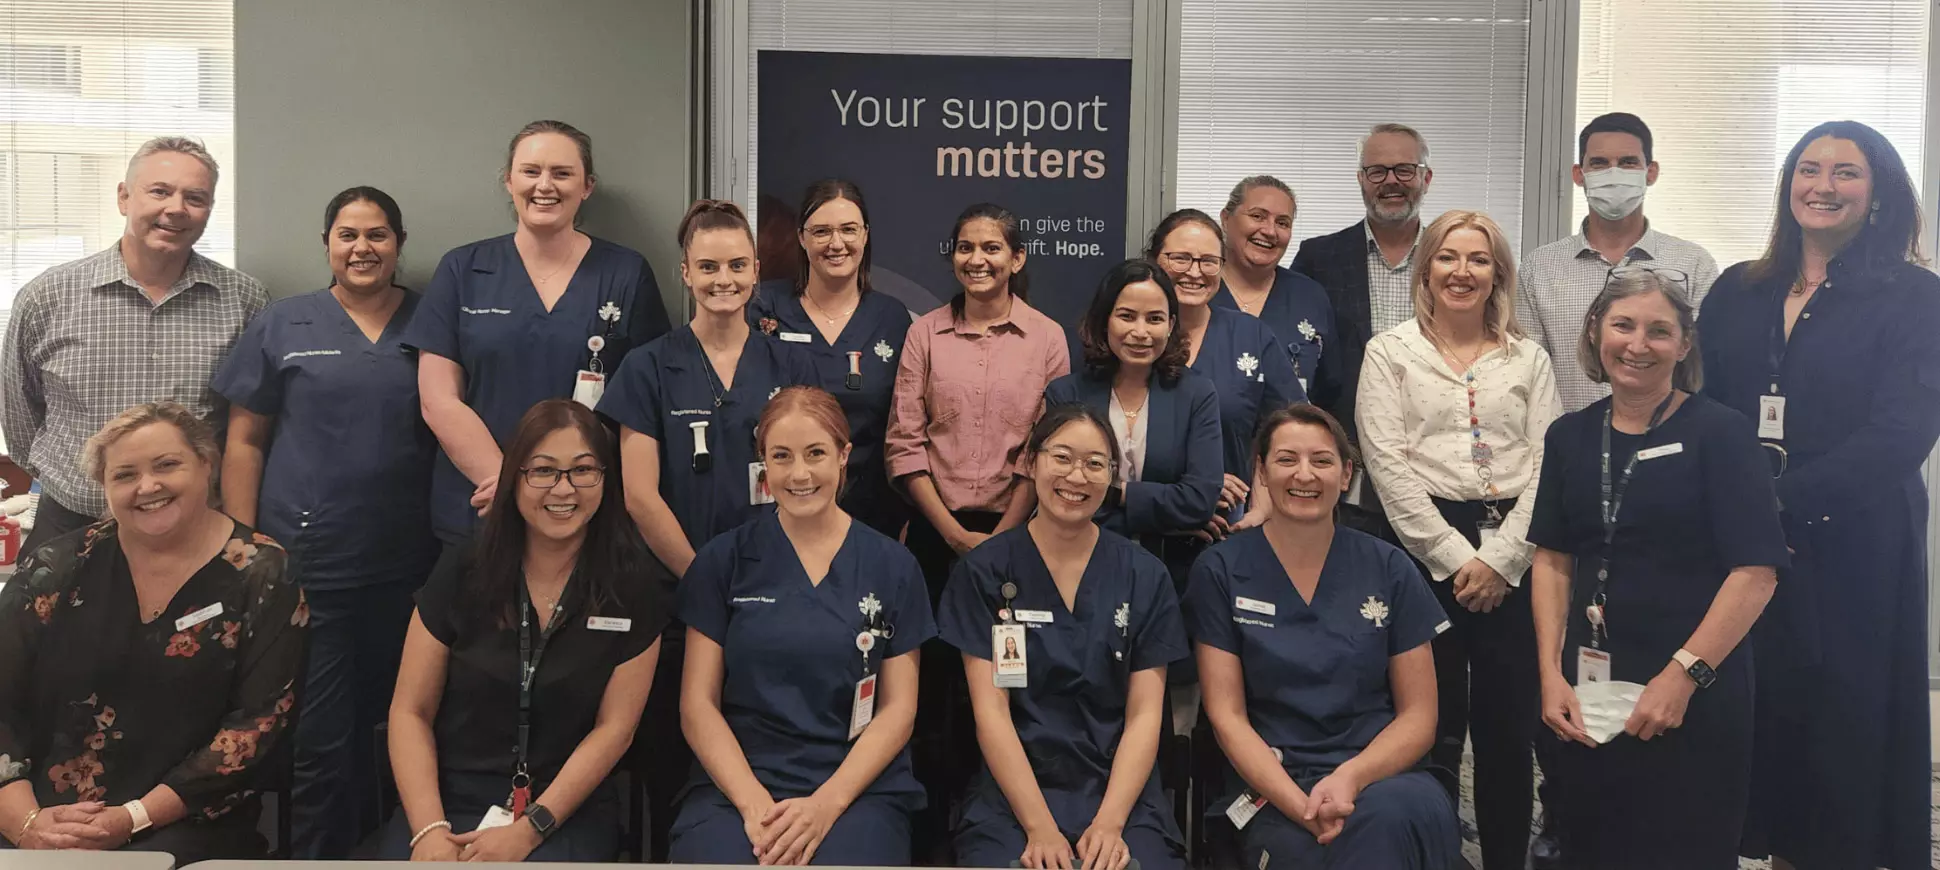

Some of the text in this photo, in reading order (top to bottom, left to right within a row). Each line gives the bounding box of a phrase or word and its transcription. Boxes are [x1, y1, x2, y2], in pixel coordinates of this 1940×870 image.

[830, 88, 1108, 136] Your support
[936, 141, 1106, 179] matters
[1036, 217, 1071, 235] give
[1077, 216, 1105, 232] the
[1055, 240, 1105, 258] Hope.
[670, 408, 698, 416] Registered
